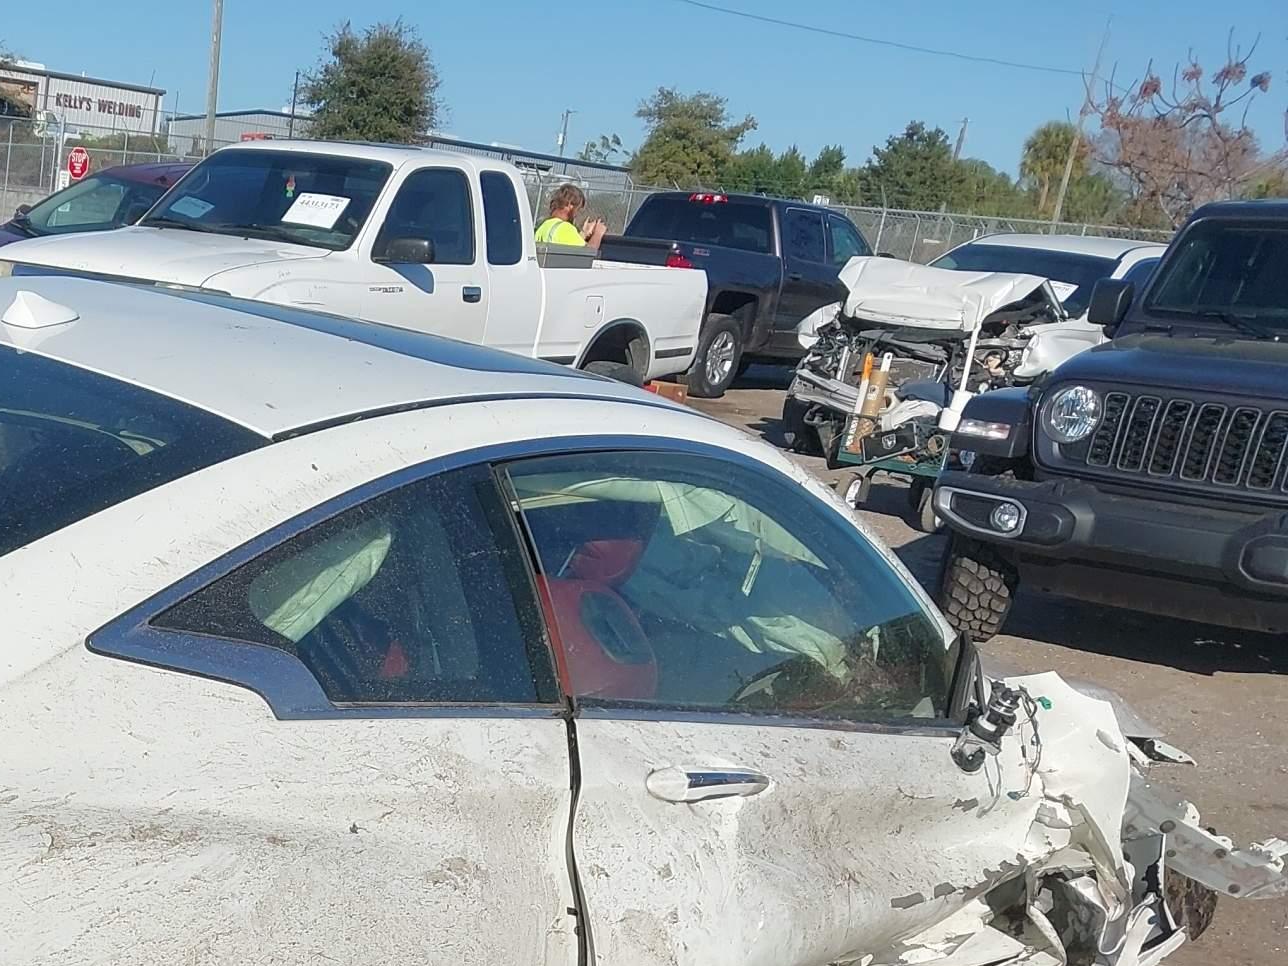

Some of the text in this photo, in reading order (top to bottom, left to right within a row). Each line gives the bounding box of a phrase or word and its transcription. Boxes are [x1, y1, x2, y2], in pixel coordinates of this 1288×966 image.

[55, 92, 142, 119] KELLY'S WELDING
[71, 152, 87, 163] STOP
